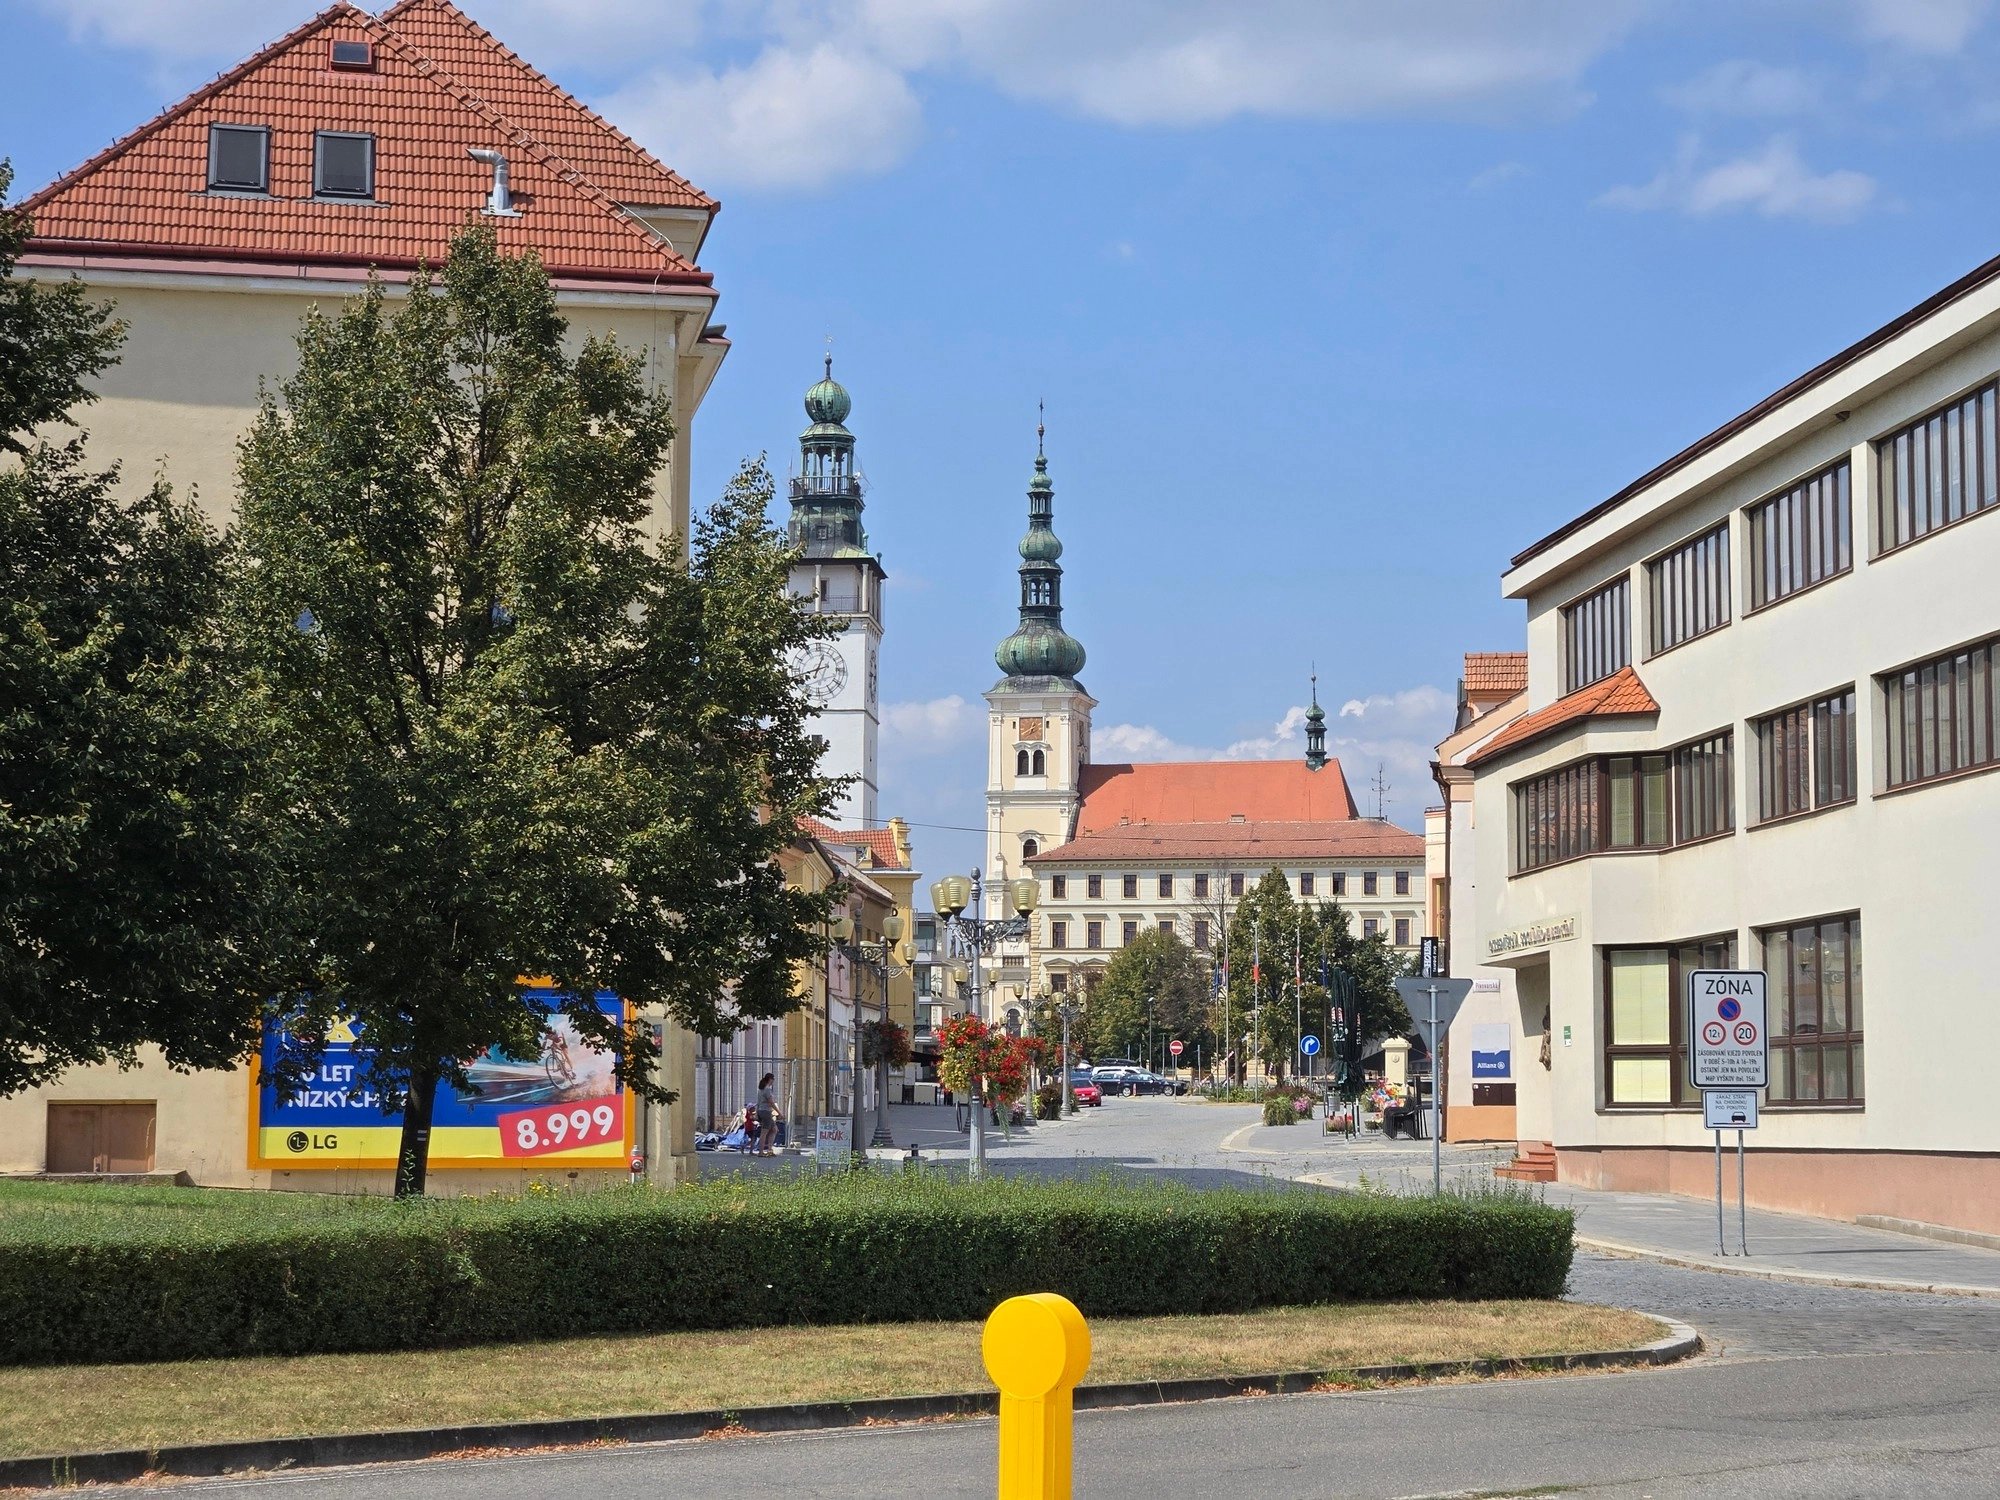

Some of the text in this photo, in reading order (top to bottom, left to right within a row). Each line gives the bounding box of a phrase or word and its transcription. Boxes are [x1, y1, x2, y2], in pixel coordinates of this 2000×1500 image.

[1423, 940, 1432, 967] HOLBA
[1705, 976, 1753, 995] ZÓNA
[1738, 1028, 1752, 1040] 20
[1697, 1049, 1726, 1057] ZÁSOBOVÁNÍ
[321, 1065, 355, 1082] LET
[1700, 1066, 1719, 1074] OSTATNÍ
[1738, 1066, 1761, 1074] POVOLENÍ
[517, 1105, 614, 1149] 8.999
[313, 1134, 338, 1150] LG
